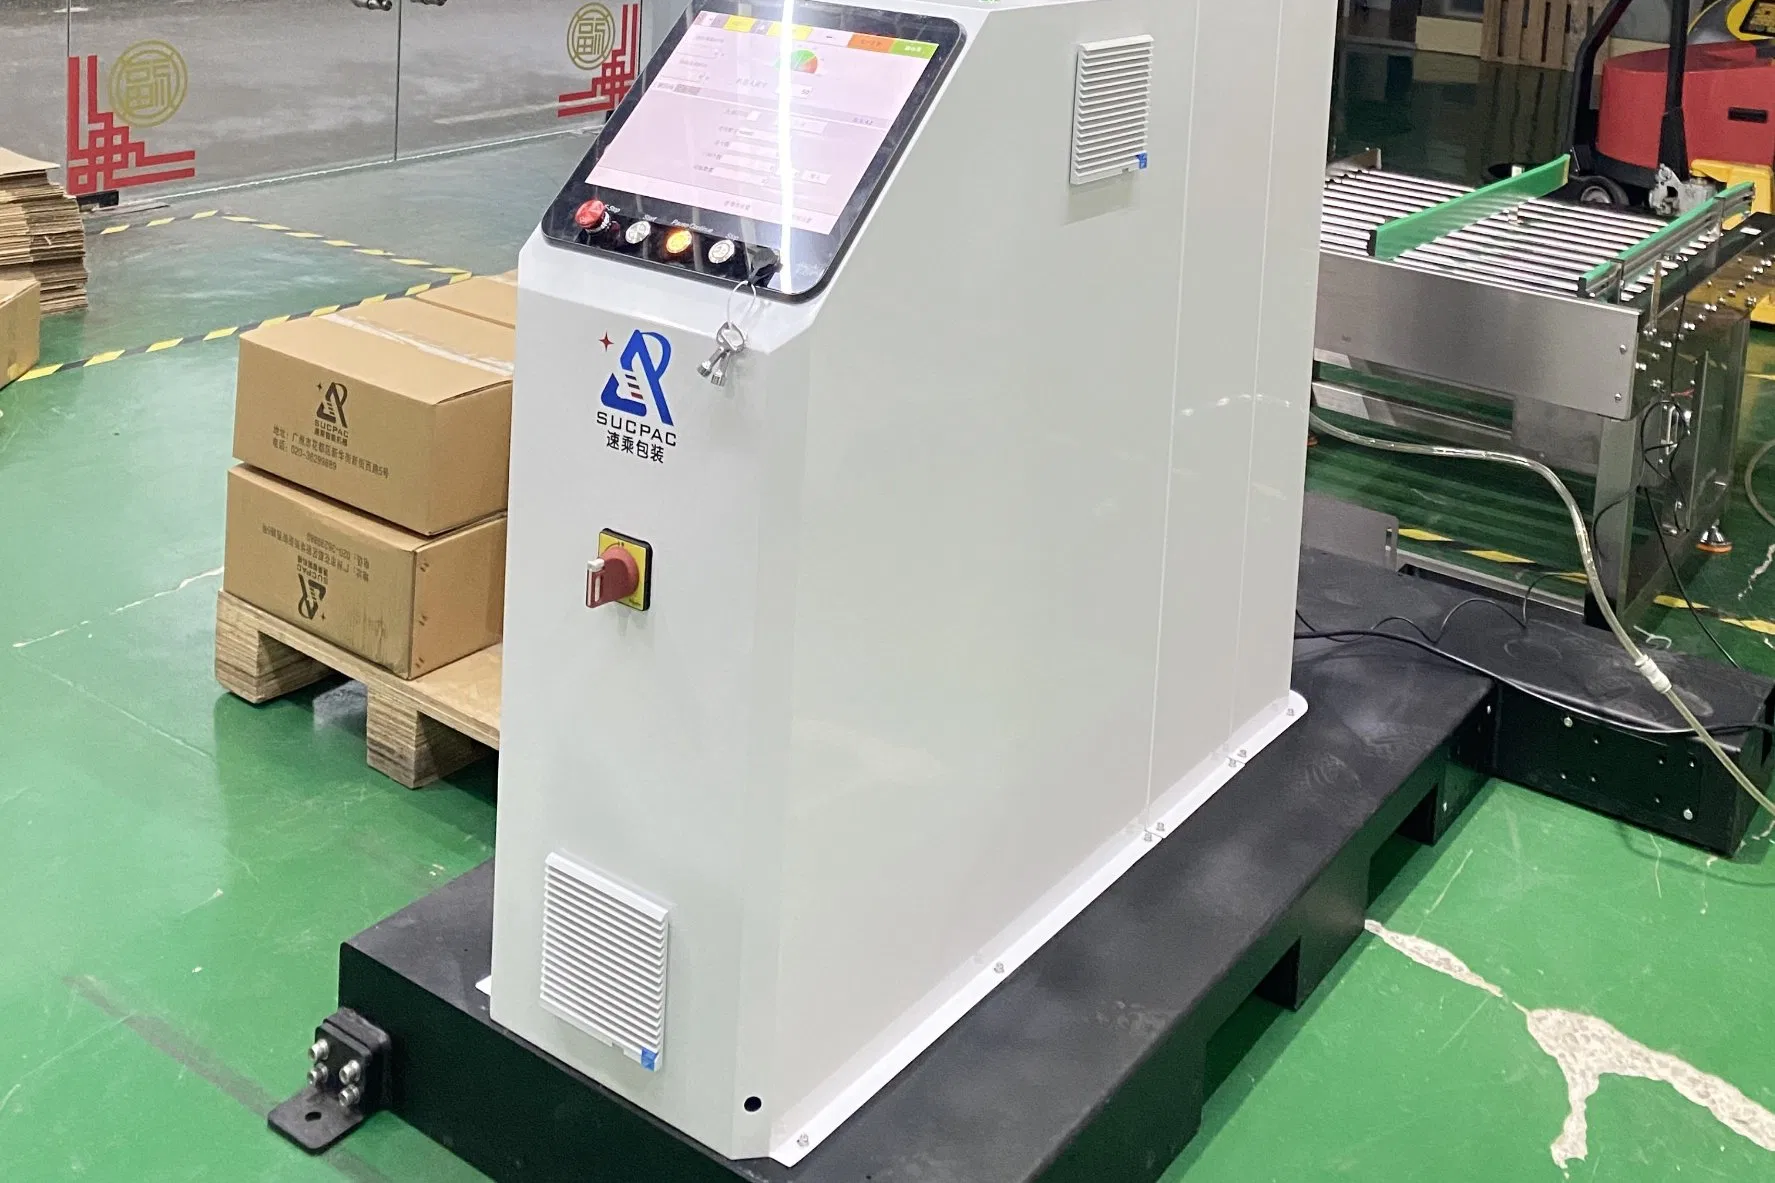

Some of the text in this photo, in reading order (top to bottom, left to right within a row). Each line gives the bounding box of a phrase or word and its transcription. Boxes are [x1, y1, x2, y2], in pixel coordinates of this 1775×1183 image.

[314, 419, 349, 438] SUCPAC
[596, 411, 677, 447] SUCPAC
[606, 429, 664, 464] 速乘包装
